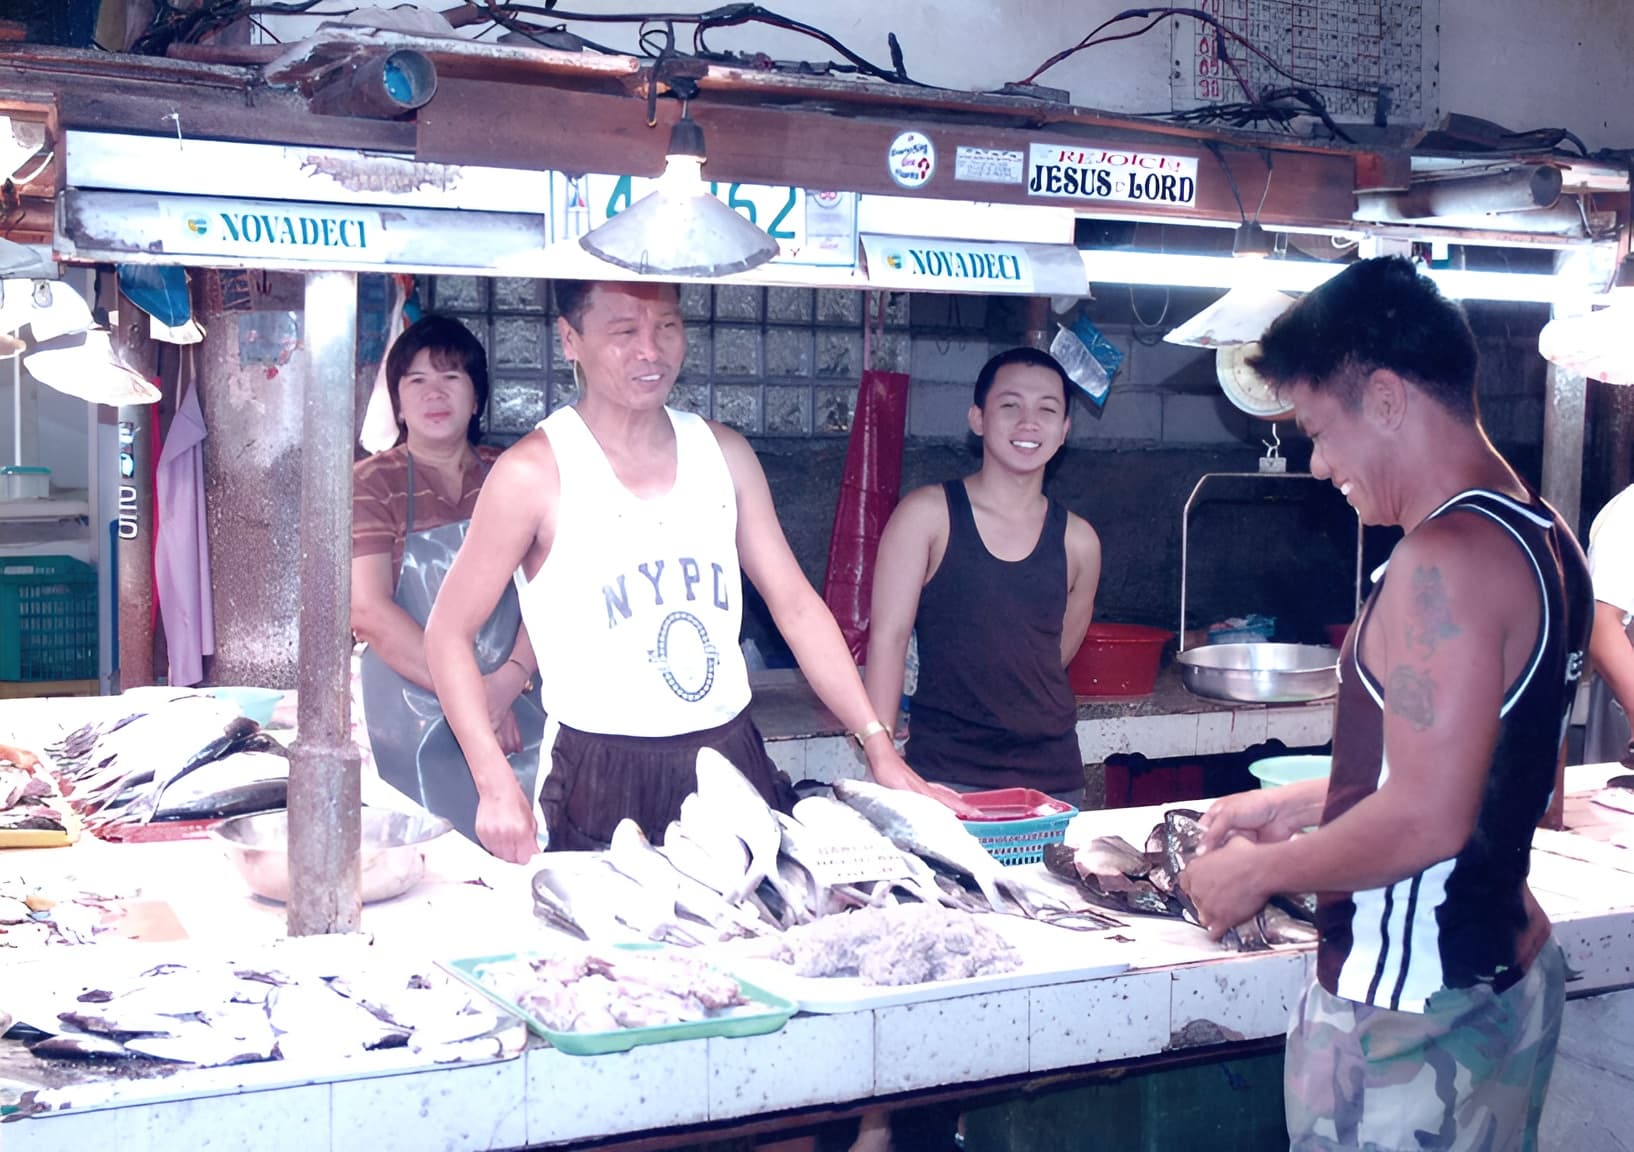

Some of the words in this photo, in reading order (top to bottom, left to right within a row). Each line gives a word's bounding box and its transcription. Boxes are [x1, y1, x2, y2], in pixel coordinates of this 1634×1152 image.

[1030, 165, 1112, 197] JESUS
[1128, 173, 1194, 203] LORD
[219, 213, 367, 248] NOVADECI
[908, 249, 1021, 280] NOVADECI
